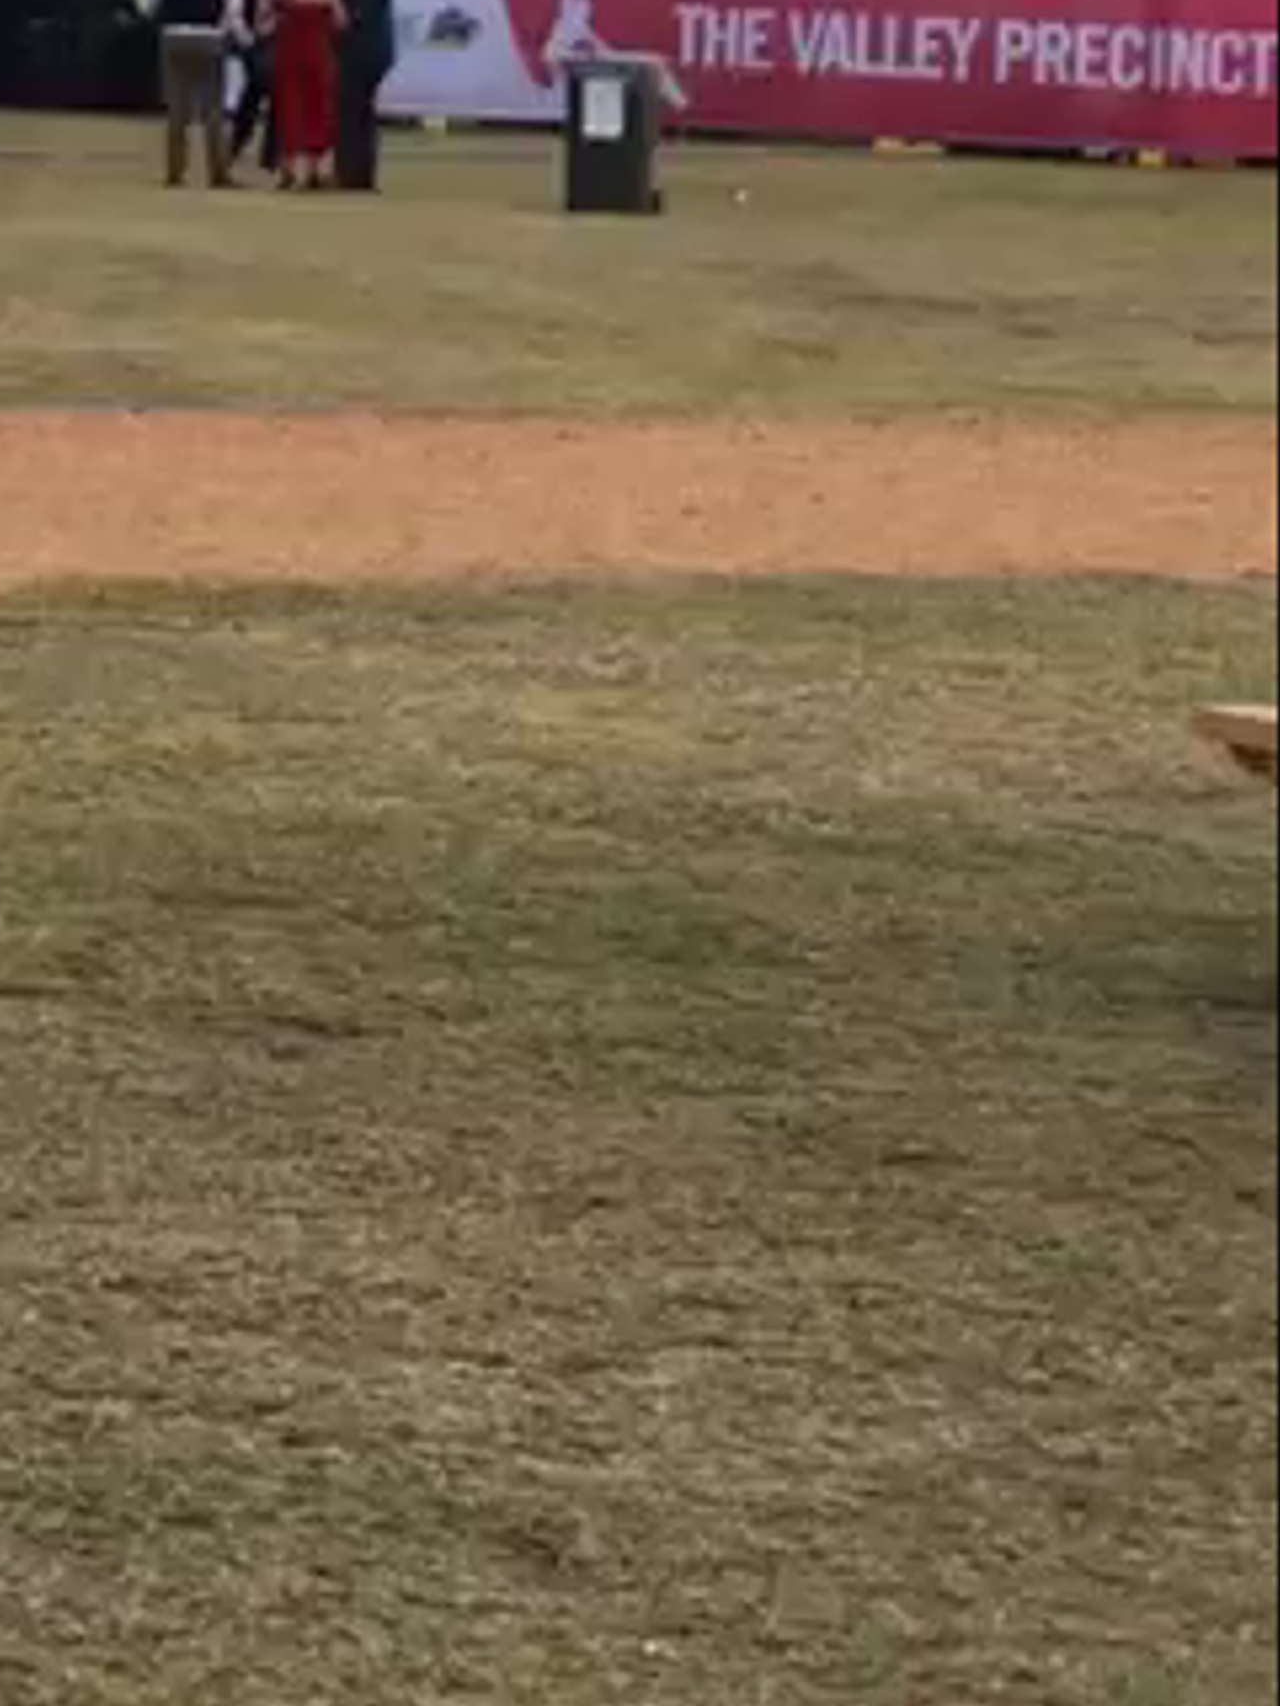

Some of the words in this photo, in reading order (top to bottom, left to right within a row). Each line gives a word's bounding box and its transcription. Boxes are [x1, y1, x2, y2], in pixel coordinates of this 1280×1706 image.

[675, 3, 775, 70] THE
[786, 11, 982, 84] VALLEY
[993, 20, 1275, 98] PRECINCT
